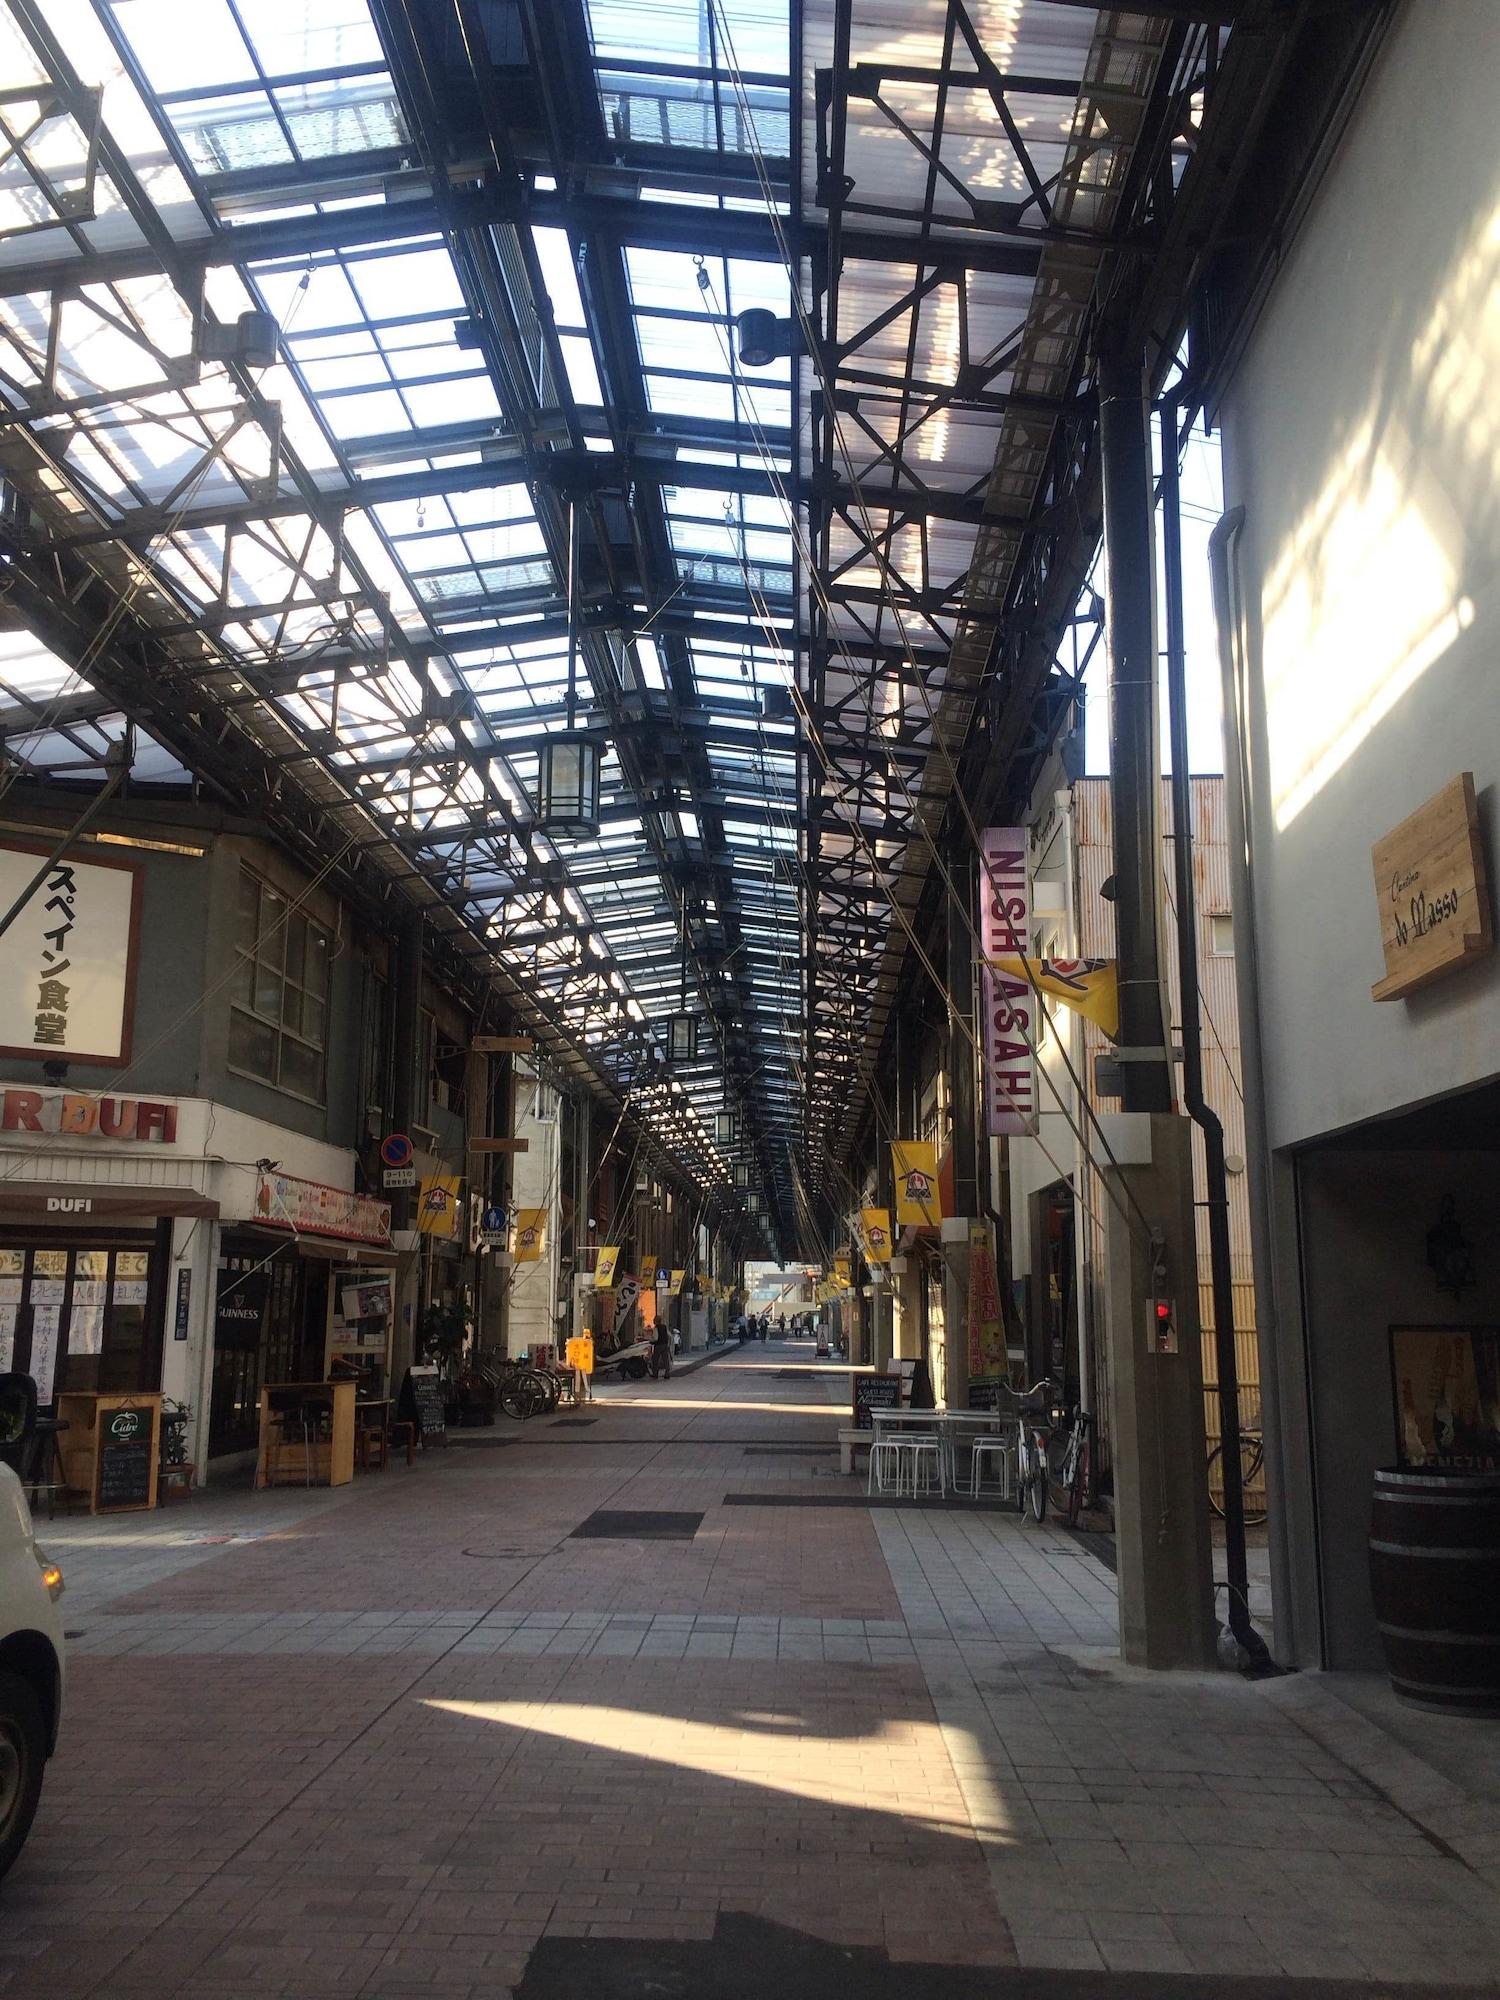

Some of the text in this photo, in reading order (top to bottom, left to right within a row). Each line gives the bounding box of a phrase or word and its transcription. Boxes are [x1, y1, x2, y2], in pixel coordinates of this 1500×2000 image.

[33, 865, 77, 1046] スペイン食堂
[61, 1094, 178, 1143] DUFI
[46, 1198, 92, 1213] DUFI
[118, 1254, 146, 1272] まで
[111, 1417, 138, 1434] Cidre
